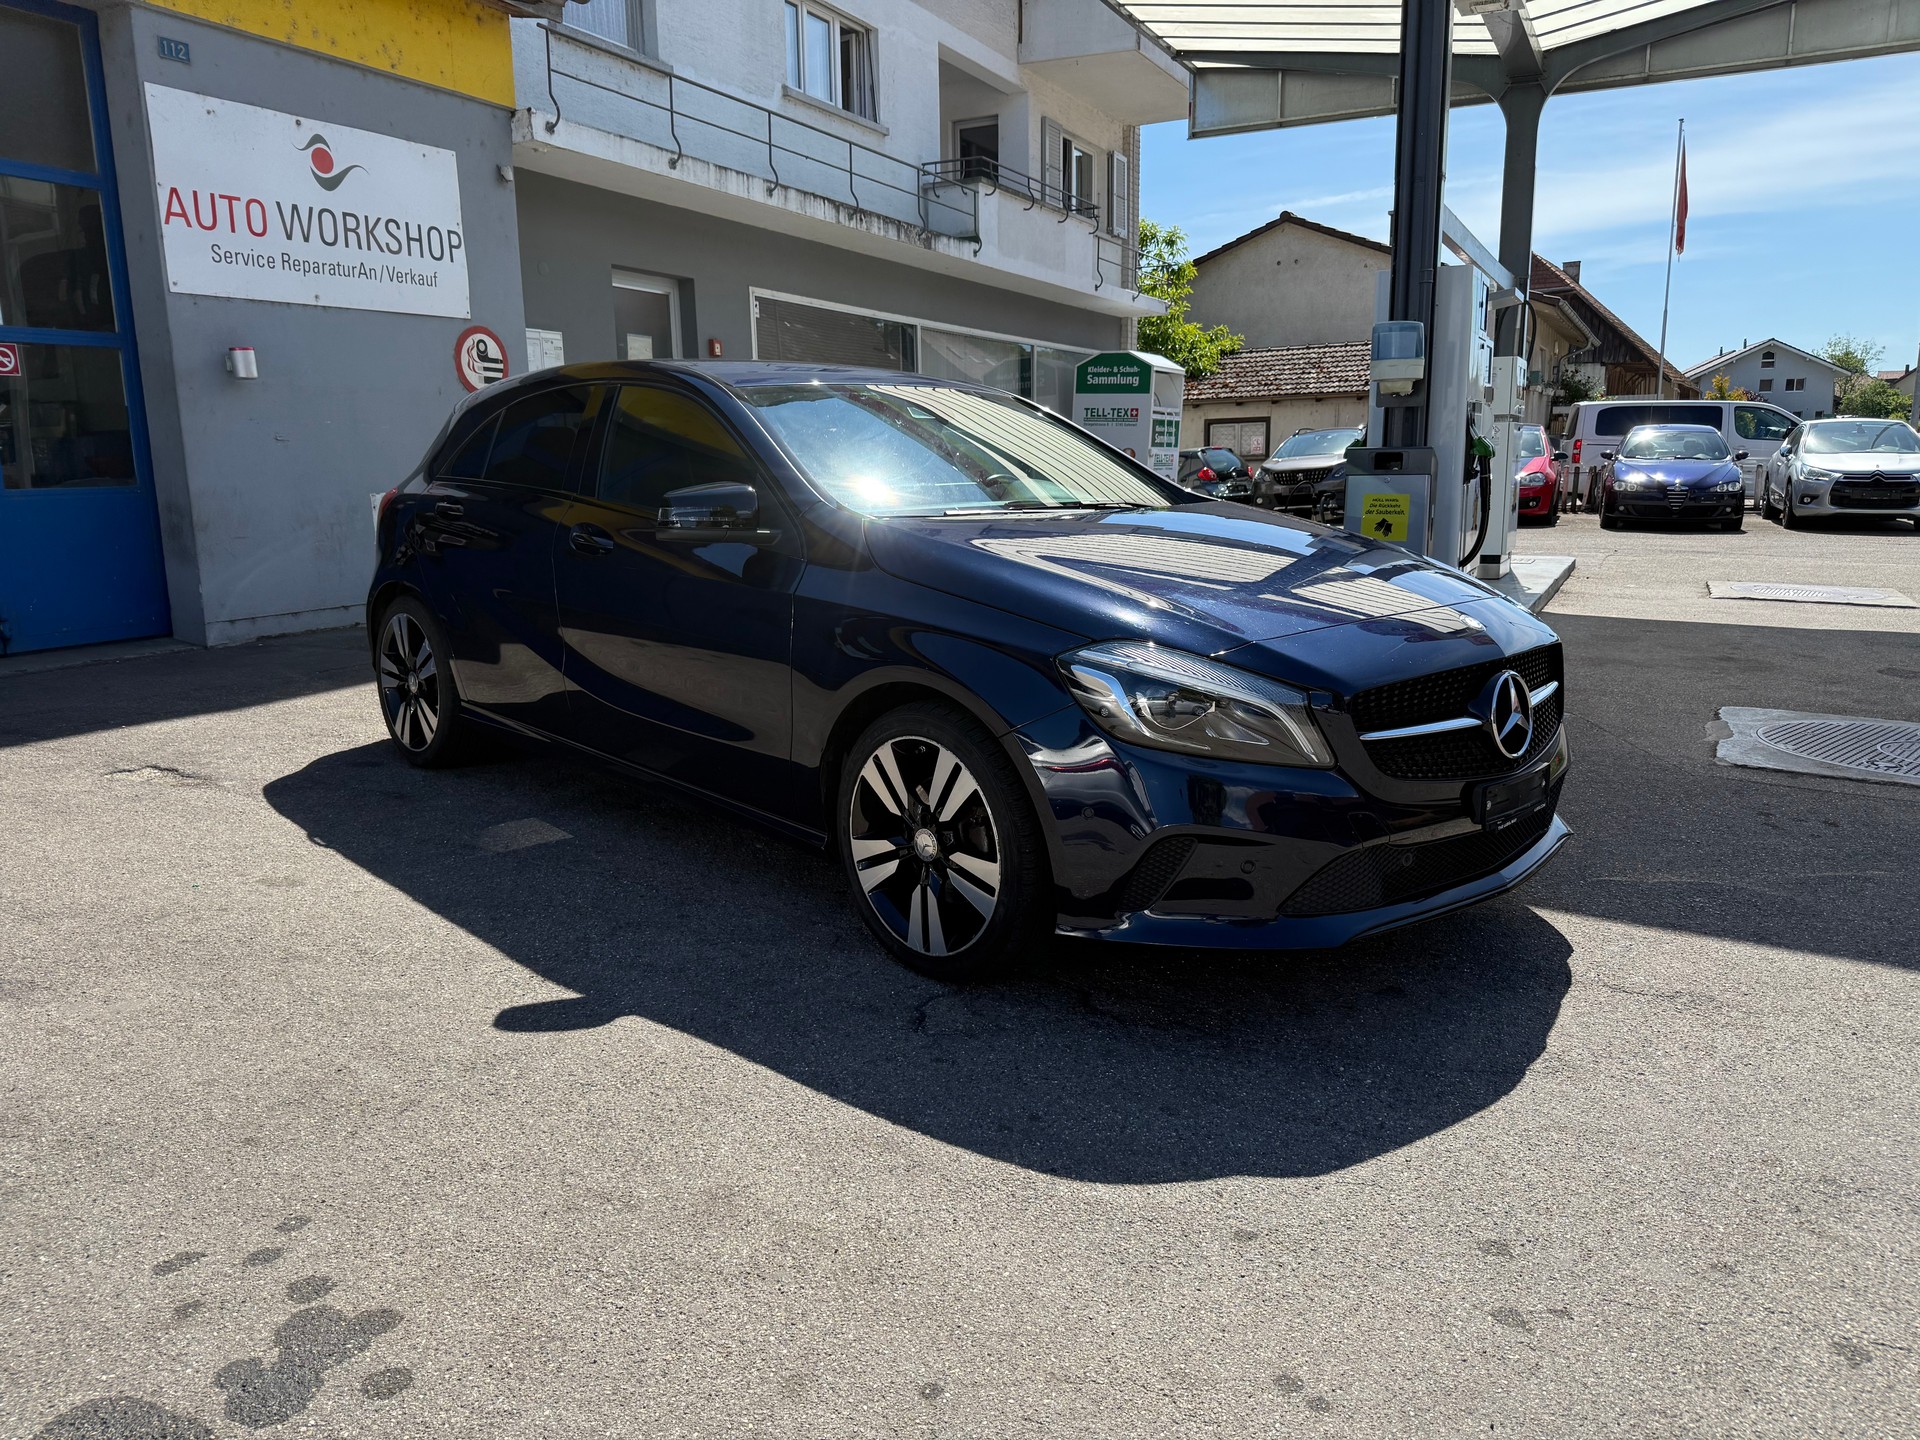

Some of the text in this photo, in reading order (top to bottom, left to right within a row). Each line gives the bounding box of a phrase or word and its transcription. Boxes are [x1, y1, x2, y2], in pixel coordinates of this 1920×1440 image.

[163, 40, 187, 59] 112
[164, 187, 462, 263] AUTO WORKSHOP
[211, 243, 276, 270] Service
[1119, 365, 1140, 373] Schuh-
[1087, 374, 1139, 386] Sammlung
[1084, 408, 1129, 417] TELL-TEX
